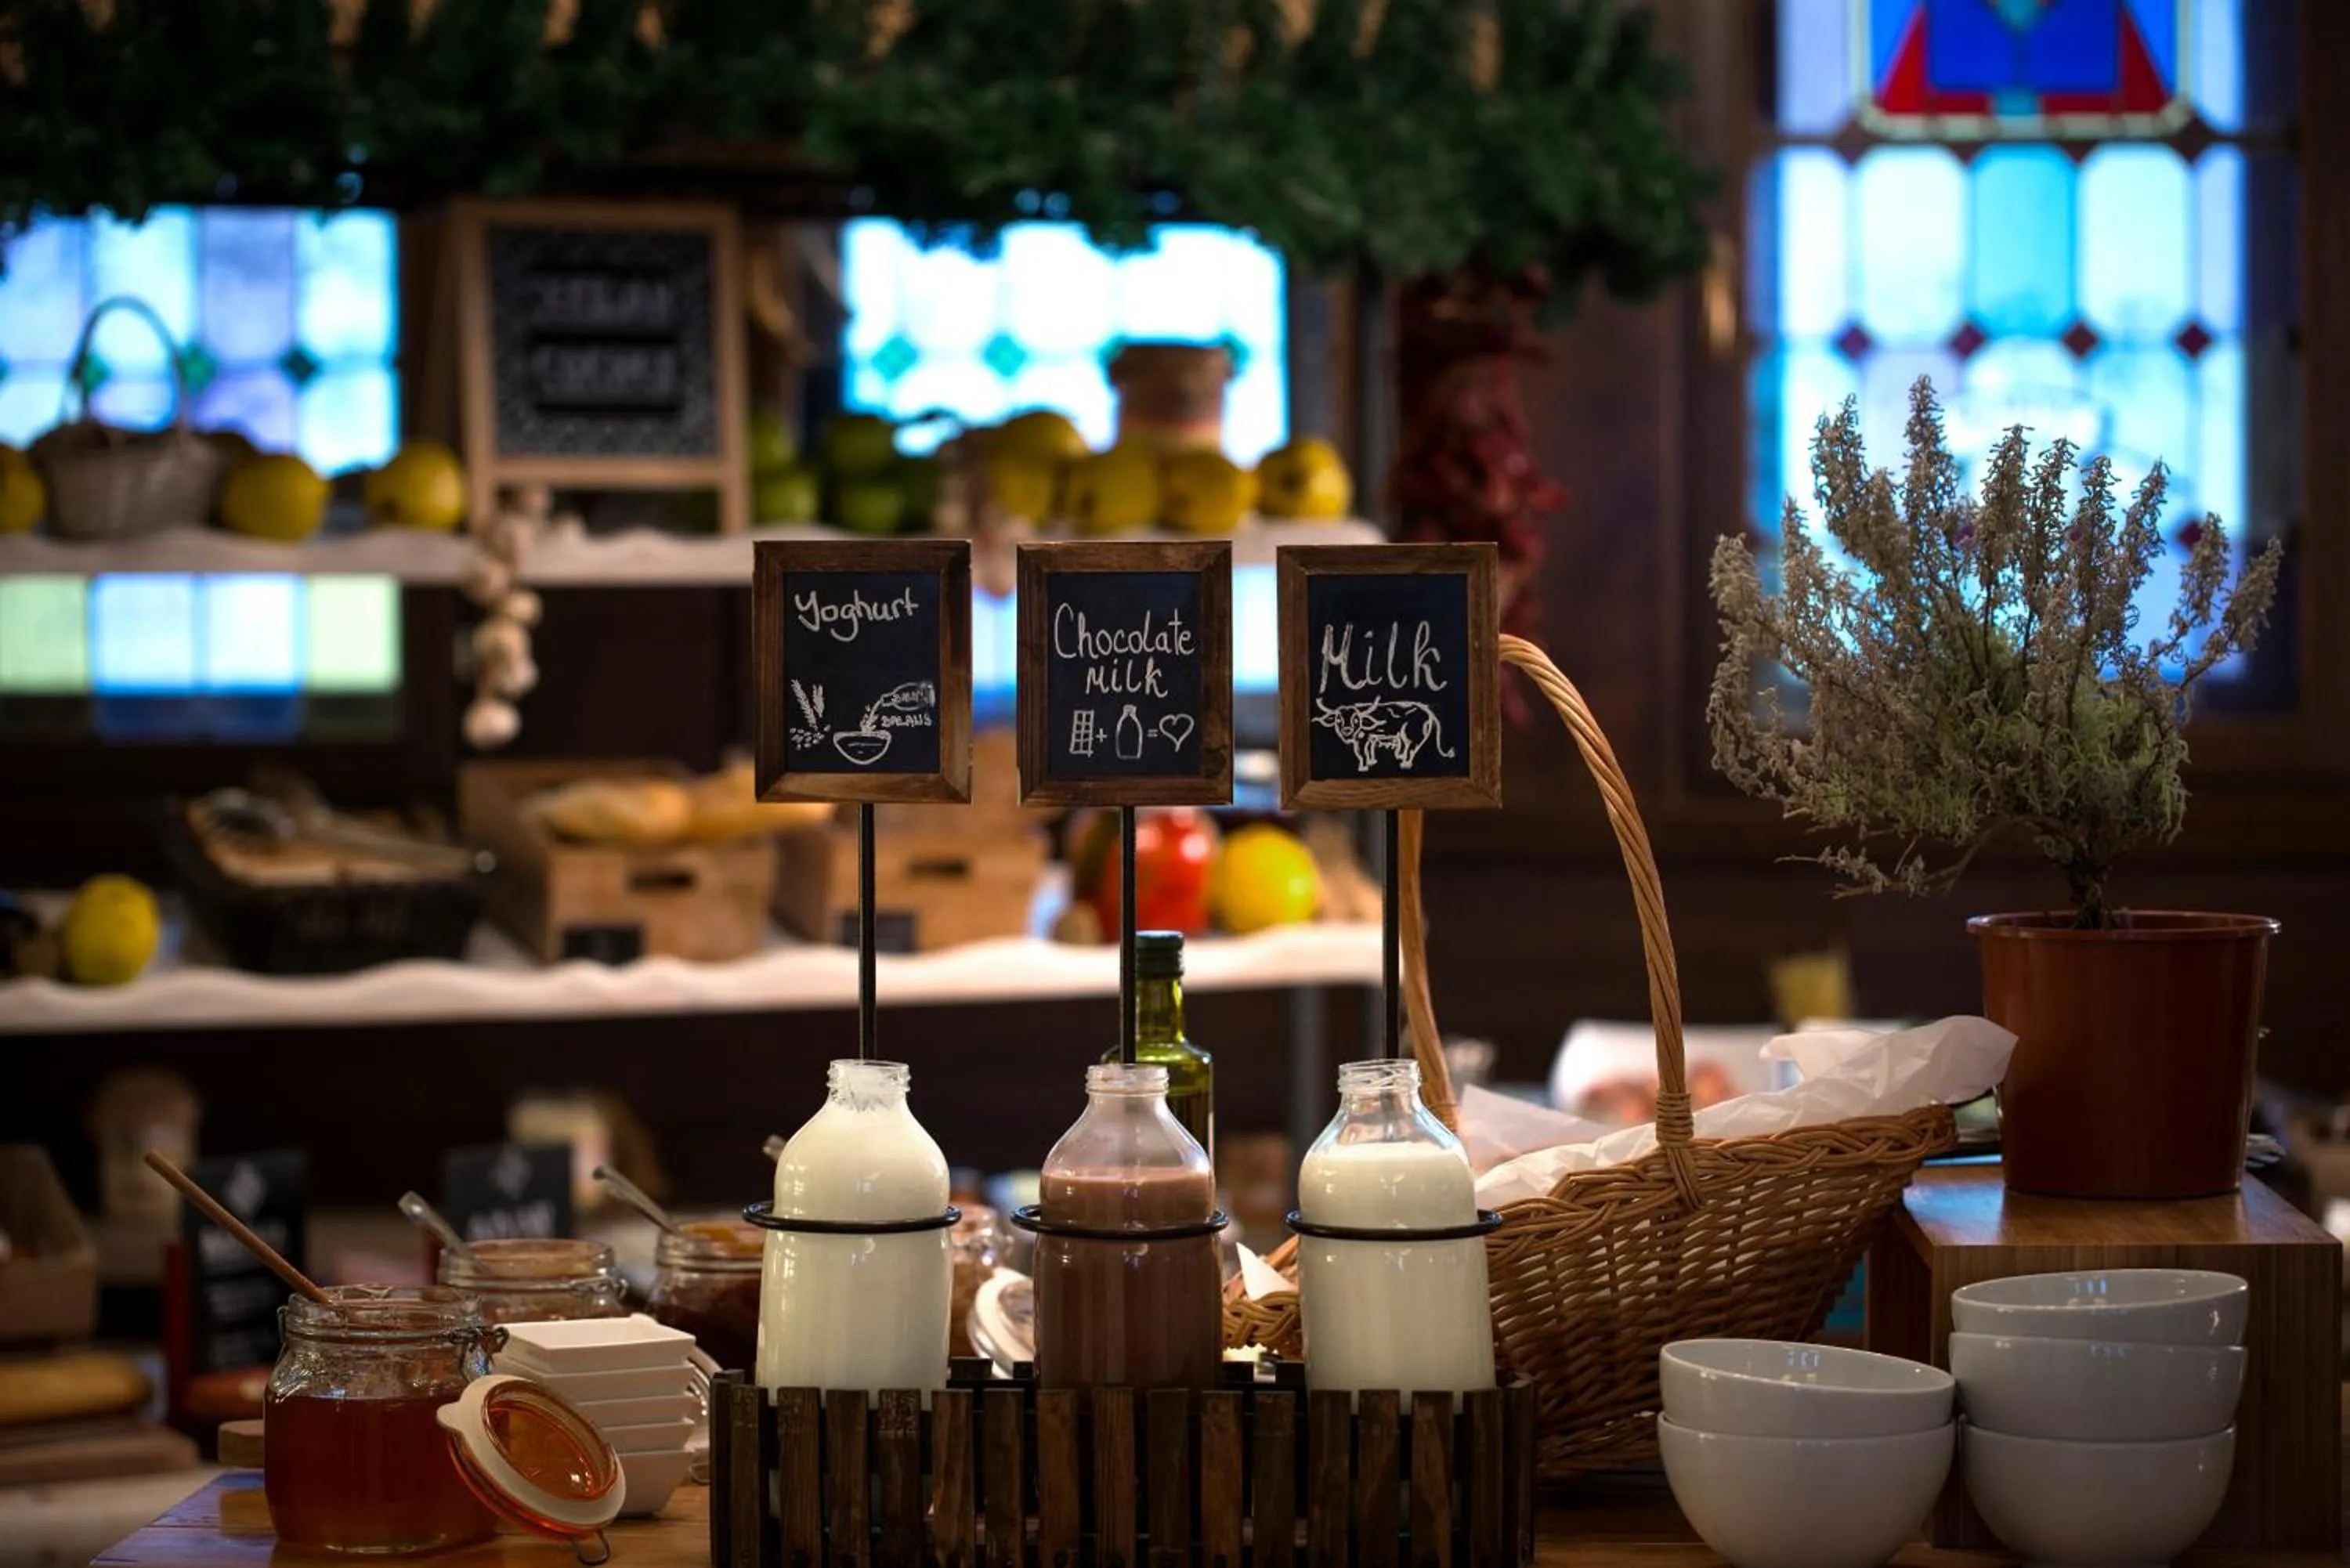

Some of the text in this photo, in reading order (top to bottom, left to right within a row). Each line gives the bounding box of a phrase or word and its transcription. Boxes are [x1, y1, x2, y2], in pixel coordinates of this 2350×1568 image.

[794, 587, 919, 641] Yoghurt
[1054, 602, 1195, 659] Chocolate
[1319, 620, 1448, 693] Milk
